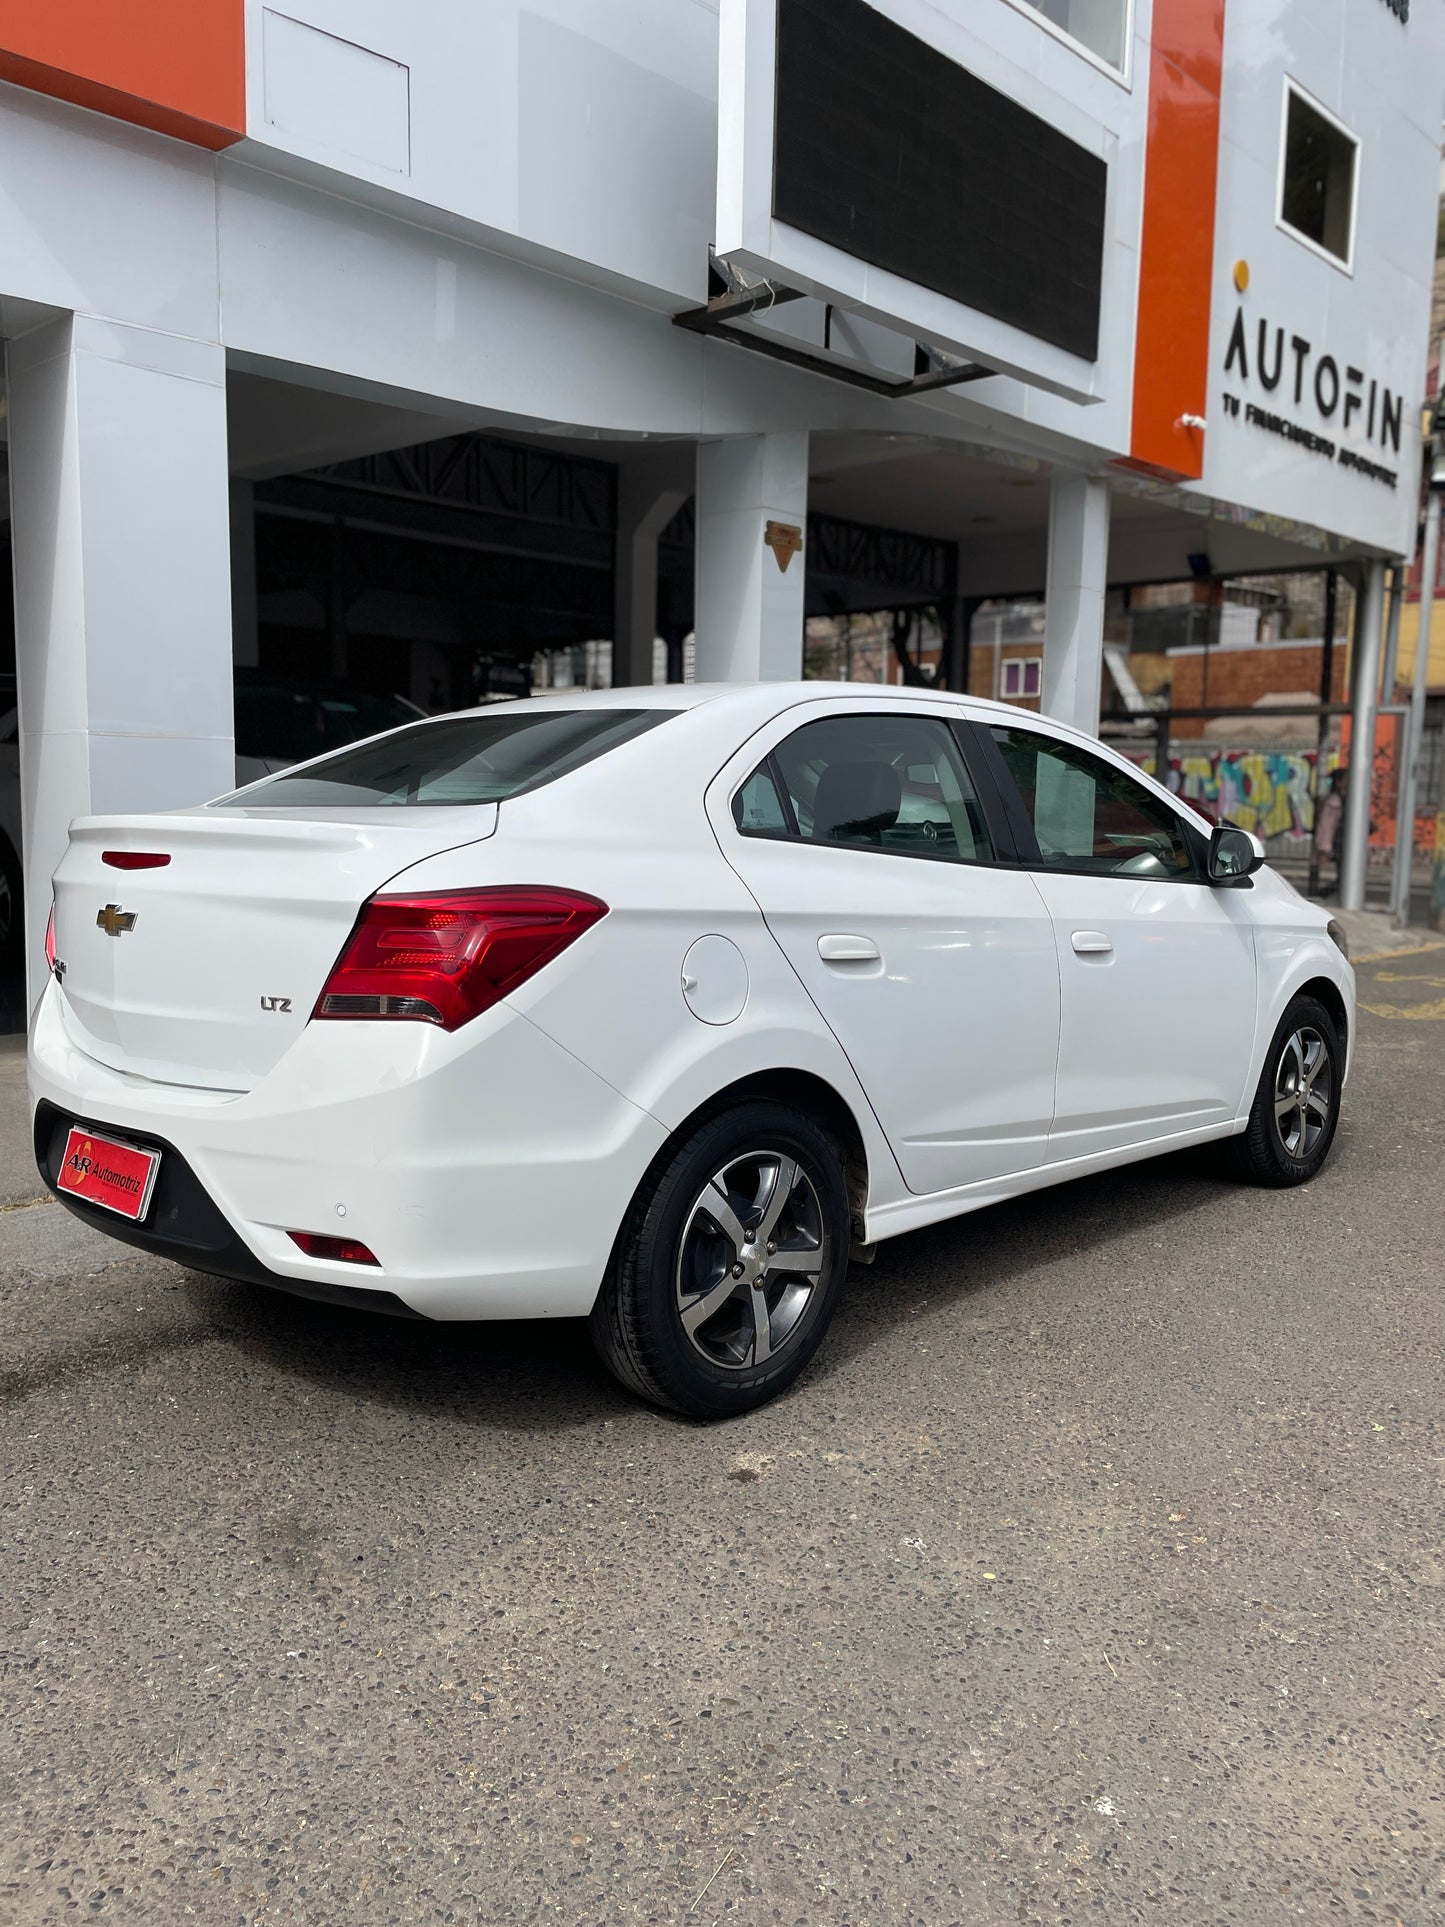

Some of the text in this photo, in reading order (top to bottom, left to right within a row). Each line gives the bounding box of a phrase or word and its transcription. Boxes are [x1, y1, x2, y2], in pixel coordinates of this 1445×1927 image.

[1223, 305, 1402, 453] AUTOFIN
[1222, 392, 1240, 417] TU
[260, 996, 292, 1013] LTZ
[91, 1162, 141, 1193] Automotriz
